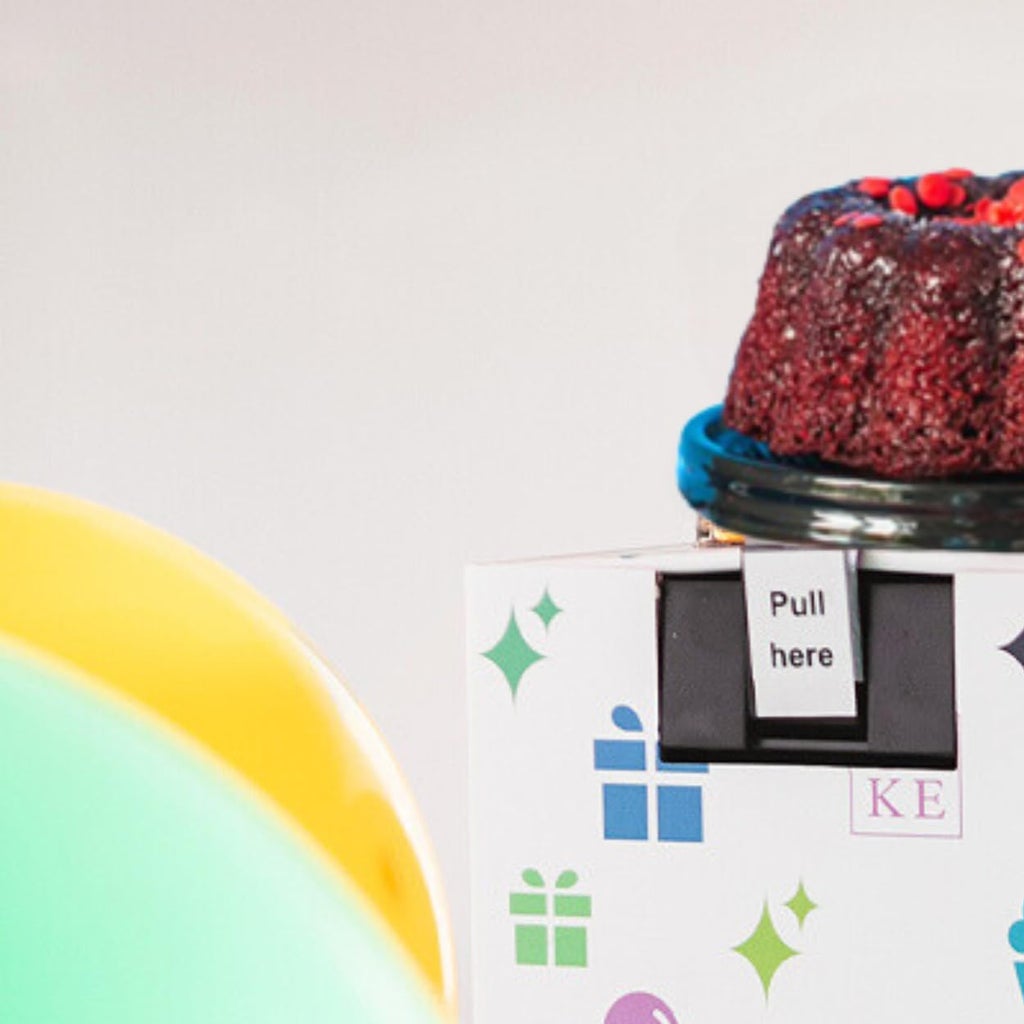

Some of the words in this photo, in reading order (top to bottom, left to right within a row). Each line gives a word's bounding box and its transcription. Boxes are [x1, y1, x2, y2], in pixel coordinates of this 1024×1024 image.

[769, 590, 825, 616] Pull
[769, 642, 833, 668] here
[868, 777, 946, 820] KE
